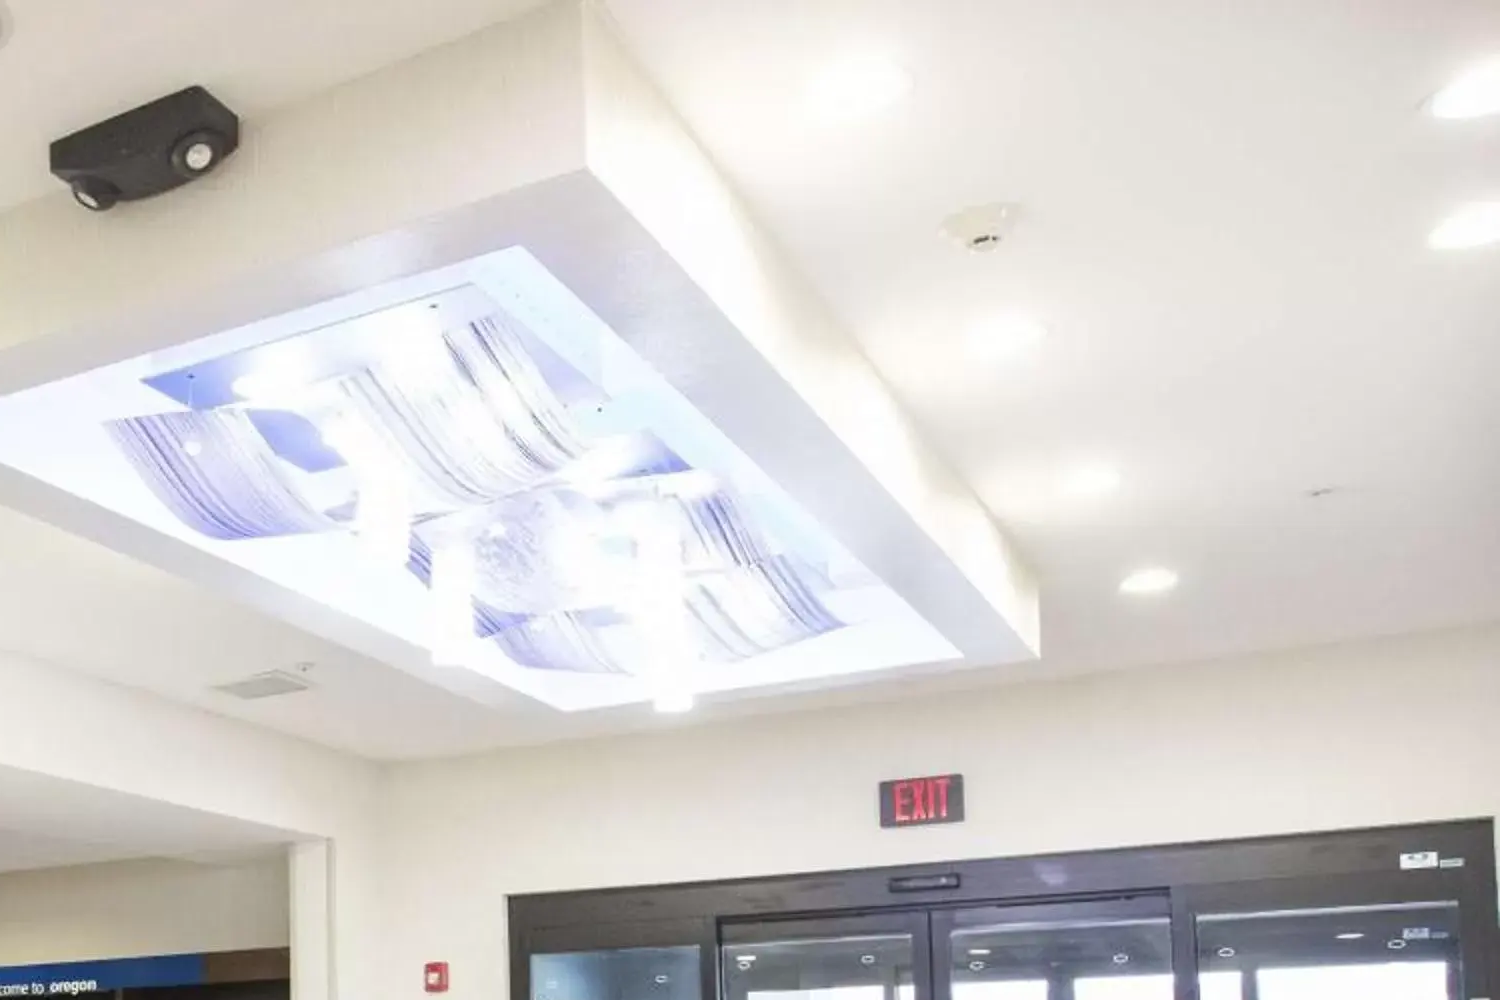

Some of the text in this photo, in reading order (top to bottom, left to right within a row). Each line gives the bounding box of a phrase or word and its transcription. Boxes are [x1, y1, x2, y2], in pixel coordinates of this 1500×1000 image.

[894, 778, 949, 821] EXIT
[32, 982, 44, 995] to
[50, 980, 97, 996] oregon
